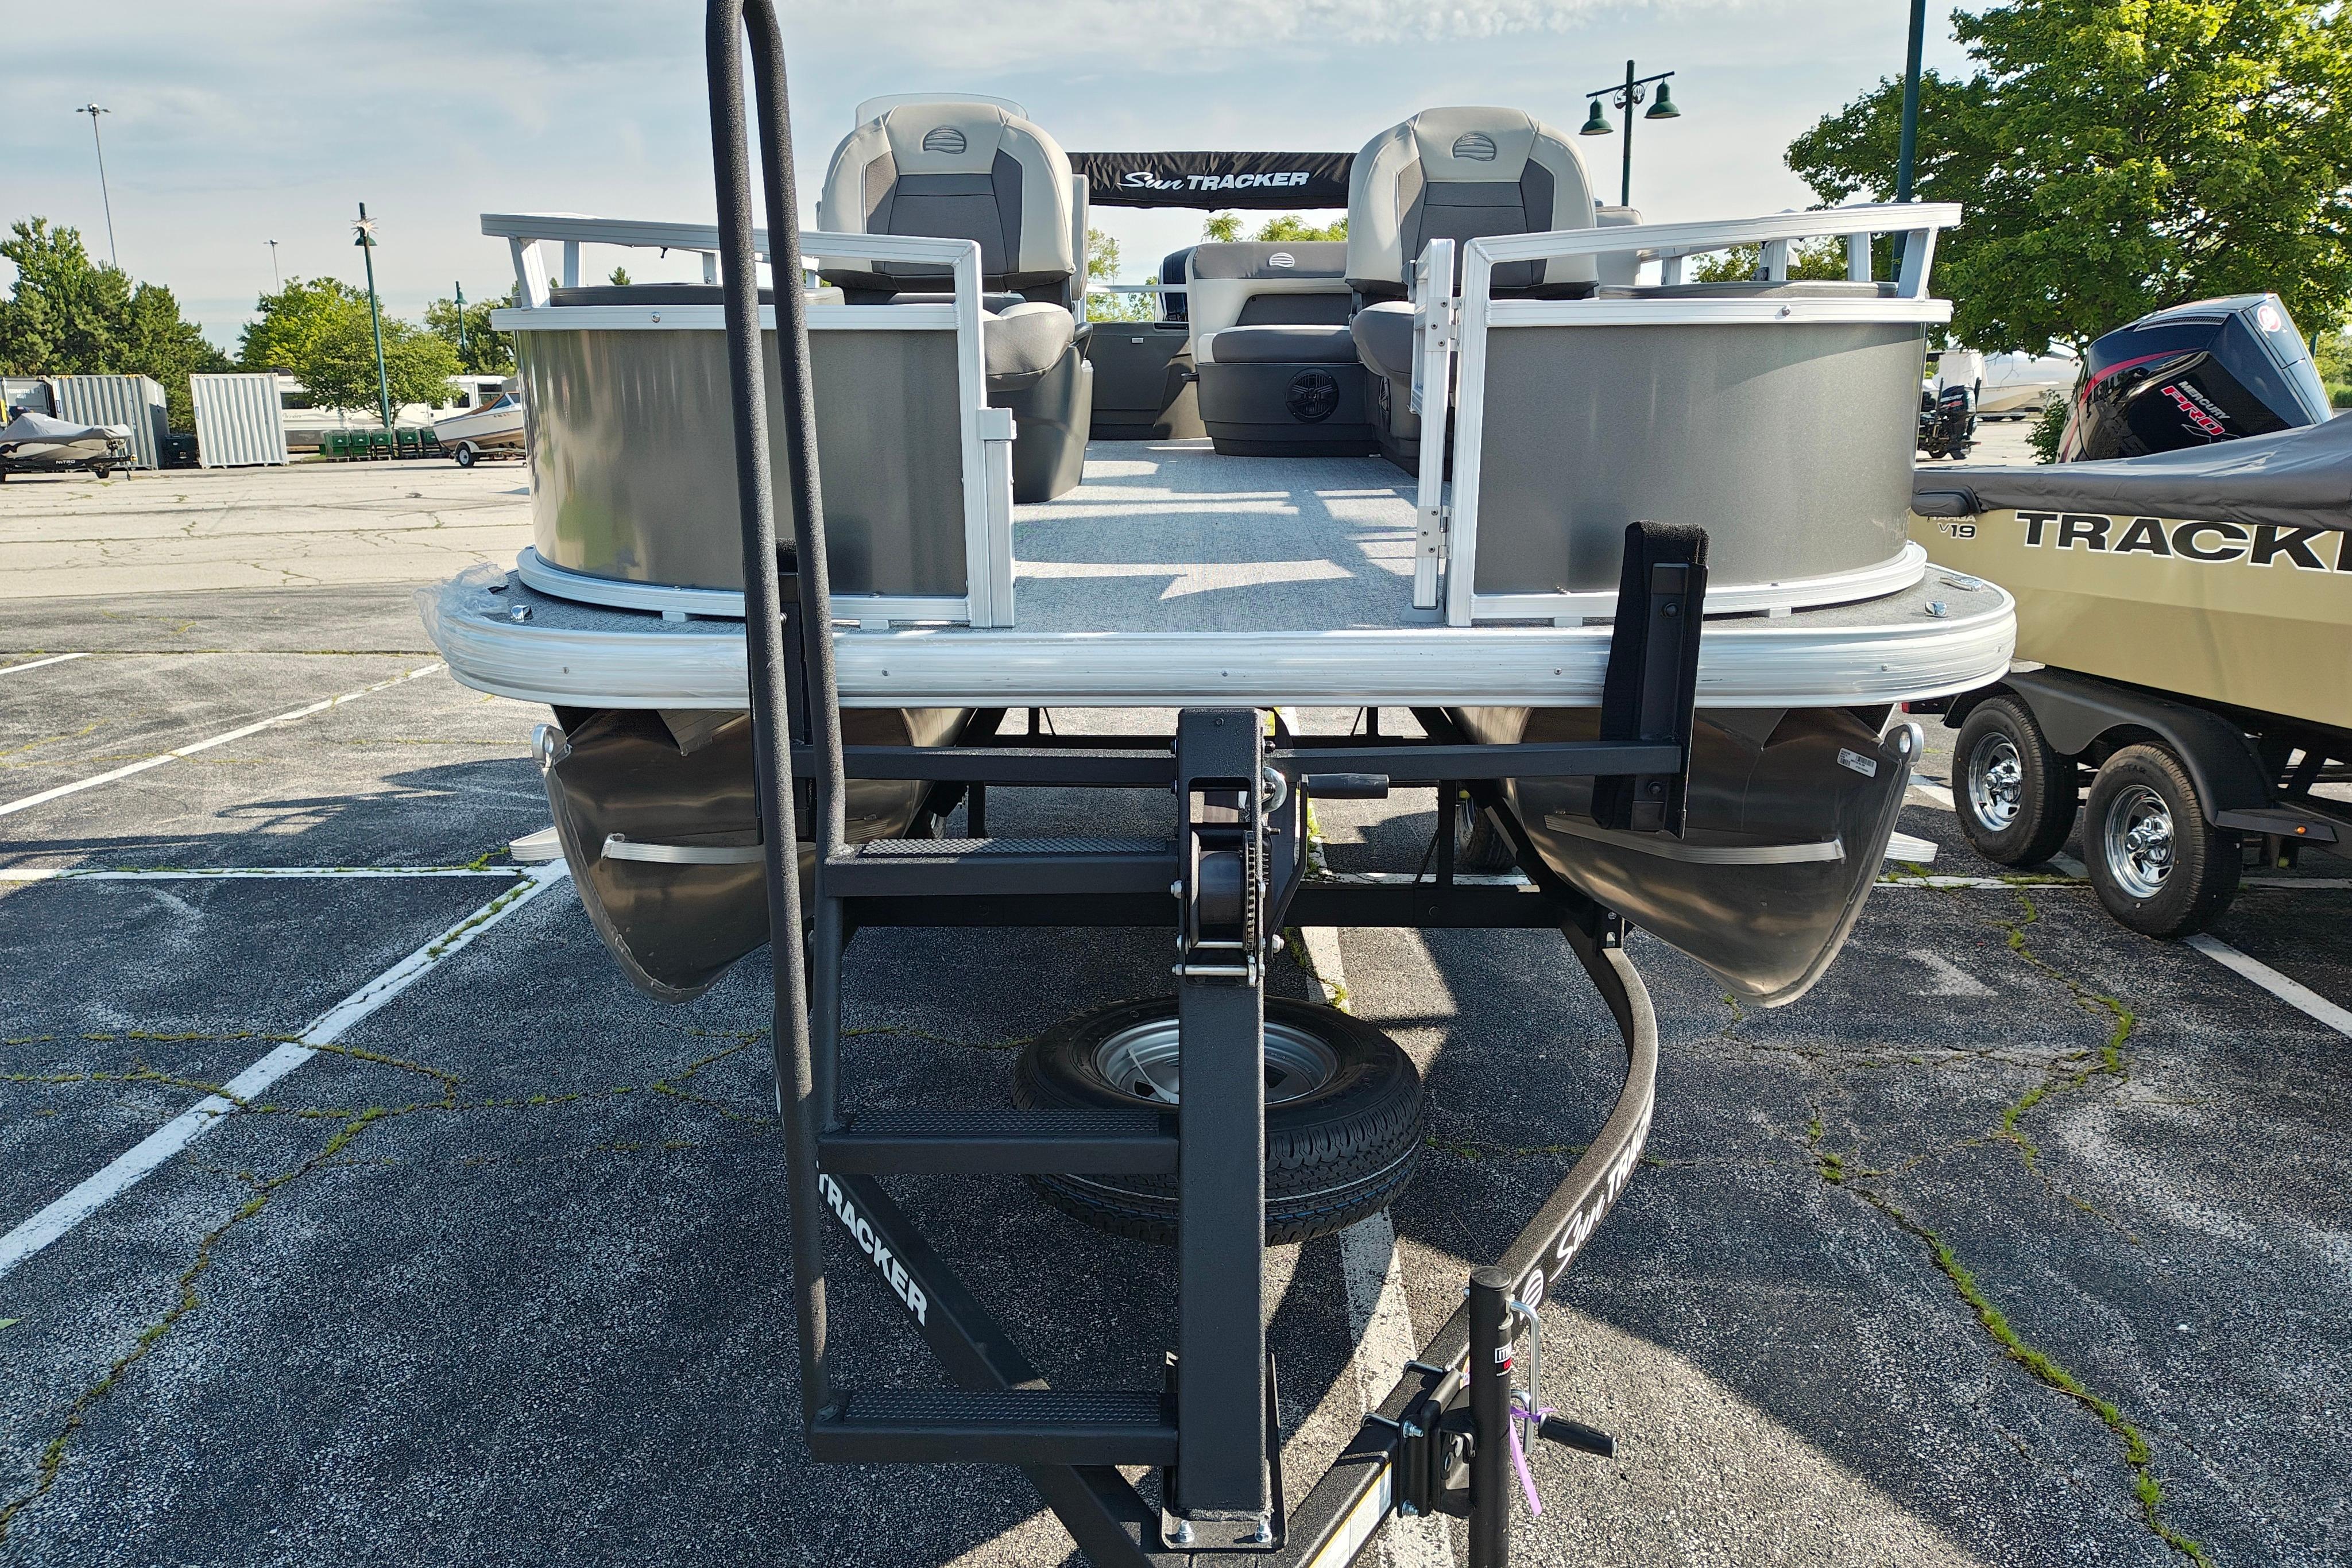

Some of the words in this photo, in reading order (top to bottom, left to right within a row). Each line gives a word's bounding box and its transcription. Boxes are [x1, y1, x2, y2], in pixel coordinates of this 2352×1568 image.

[1117, 172, 1185, 190] Sun
[1186, 172, 1310, 190] TRACKER
[2160, 385, 2225, 435] PRO
[2178, 381, 2231, 419] MERCURY
[1549, 1193, 1606, 1283] Sun
